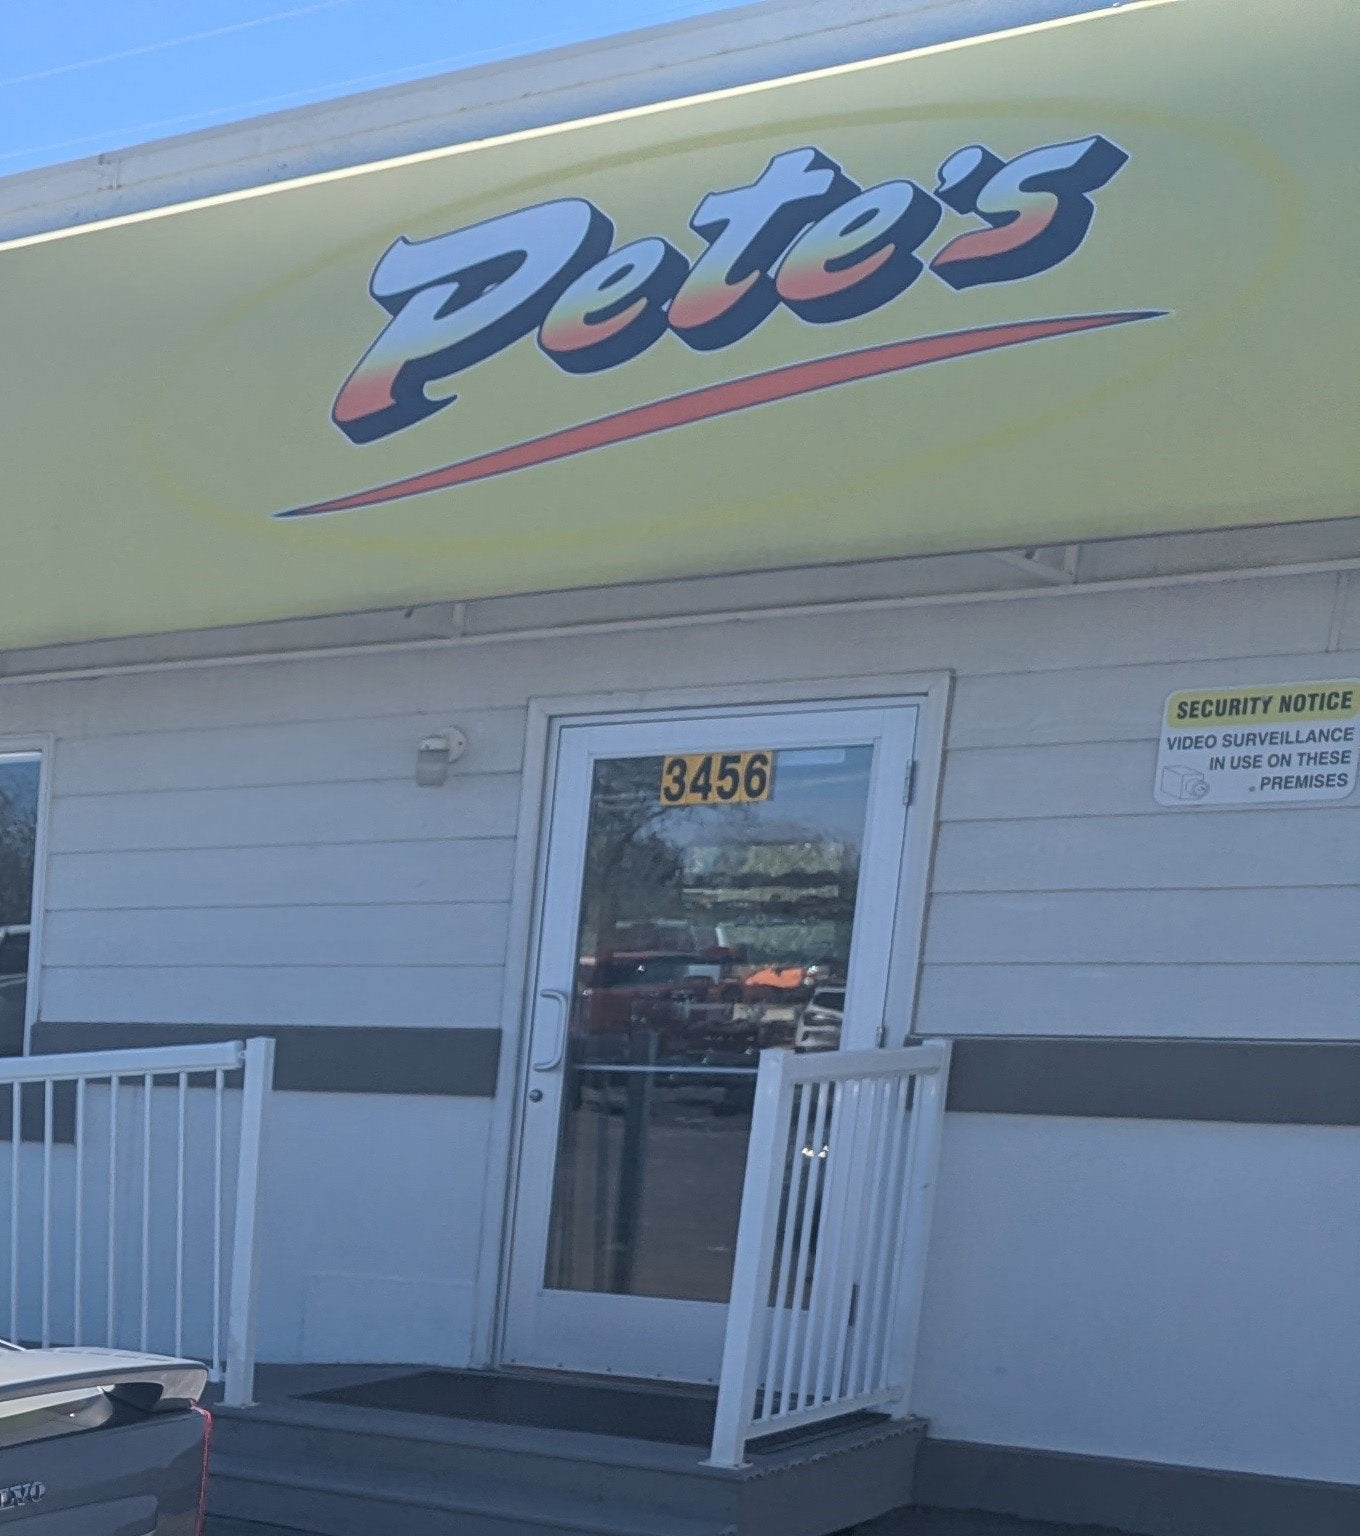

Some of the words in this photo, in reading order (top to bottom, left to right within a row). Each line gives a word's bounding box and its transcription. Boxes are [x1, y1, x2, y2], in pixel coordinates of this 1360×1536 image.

[332, 134, 1129, 444] Pete's
[1176, 695, 1273, 720] SECURITY
[1278, 690, 1354, 714] NOTICE
[1167, 733, 1217, 751] VIDEO
[1222, 726, 1355, 748] SURVEILLANCE
[1209, 756, 1225, 771] IN
[1230, 754, 1262, 770] USE
[1267, 752, 1291, 769] ON
[1297, 749, 1352, 766] THESE
[662, 753, 769, 802] 3456
[1260, 772, 1349, 791] PREMISES
